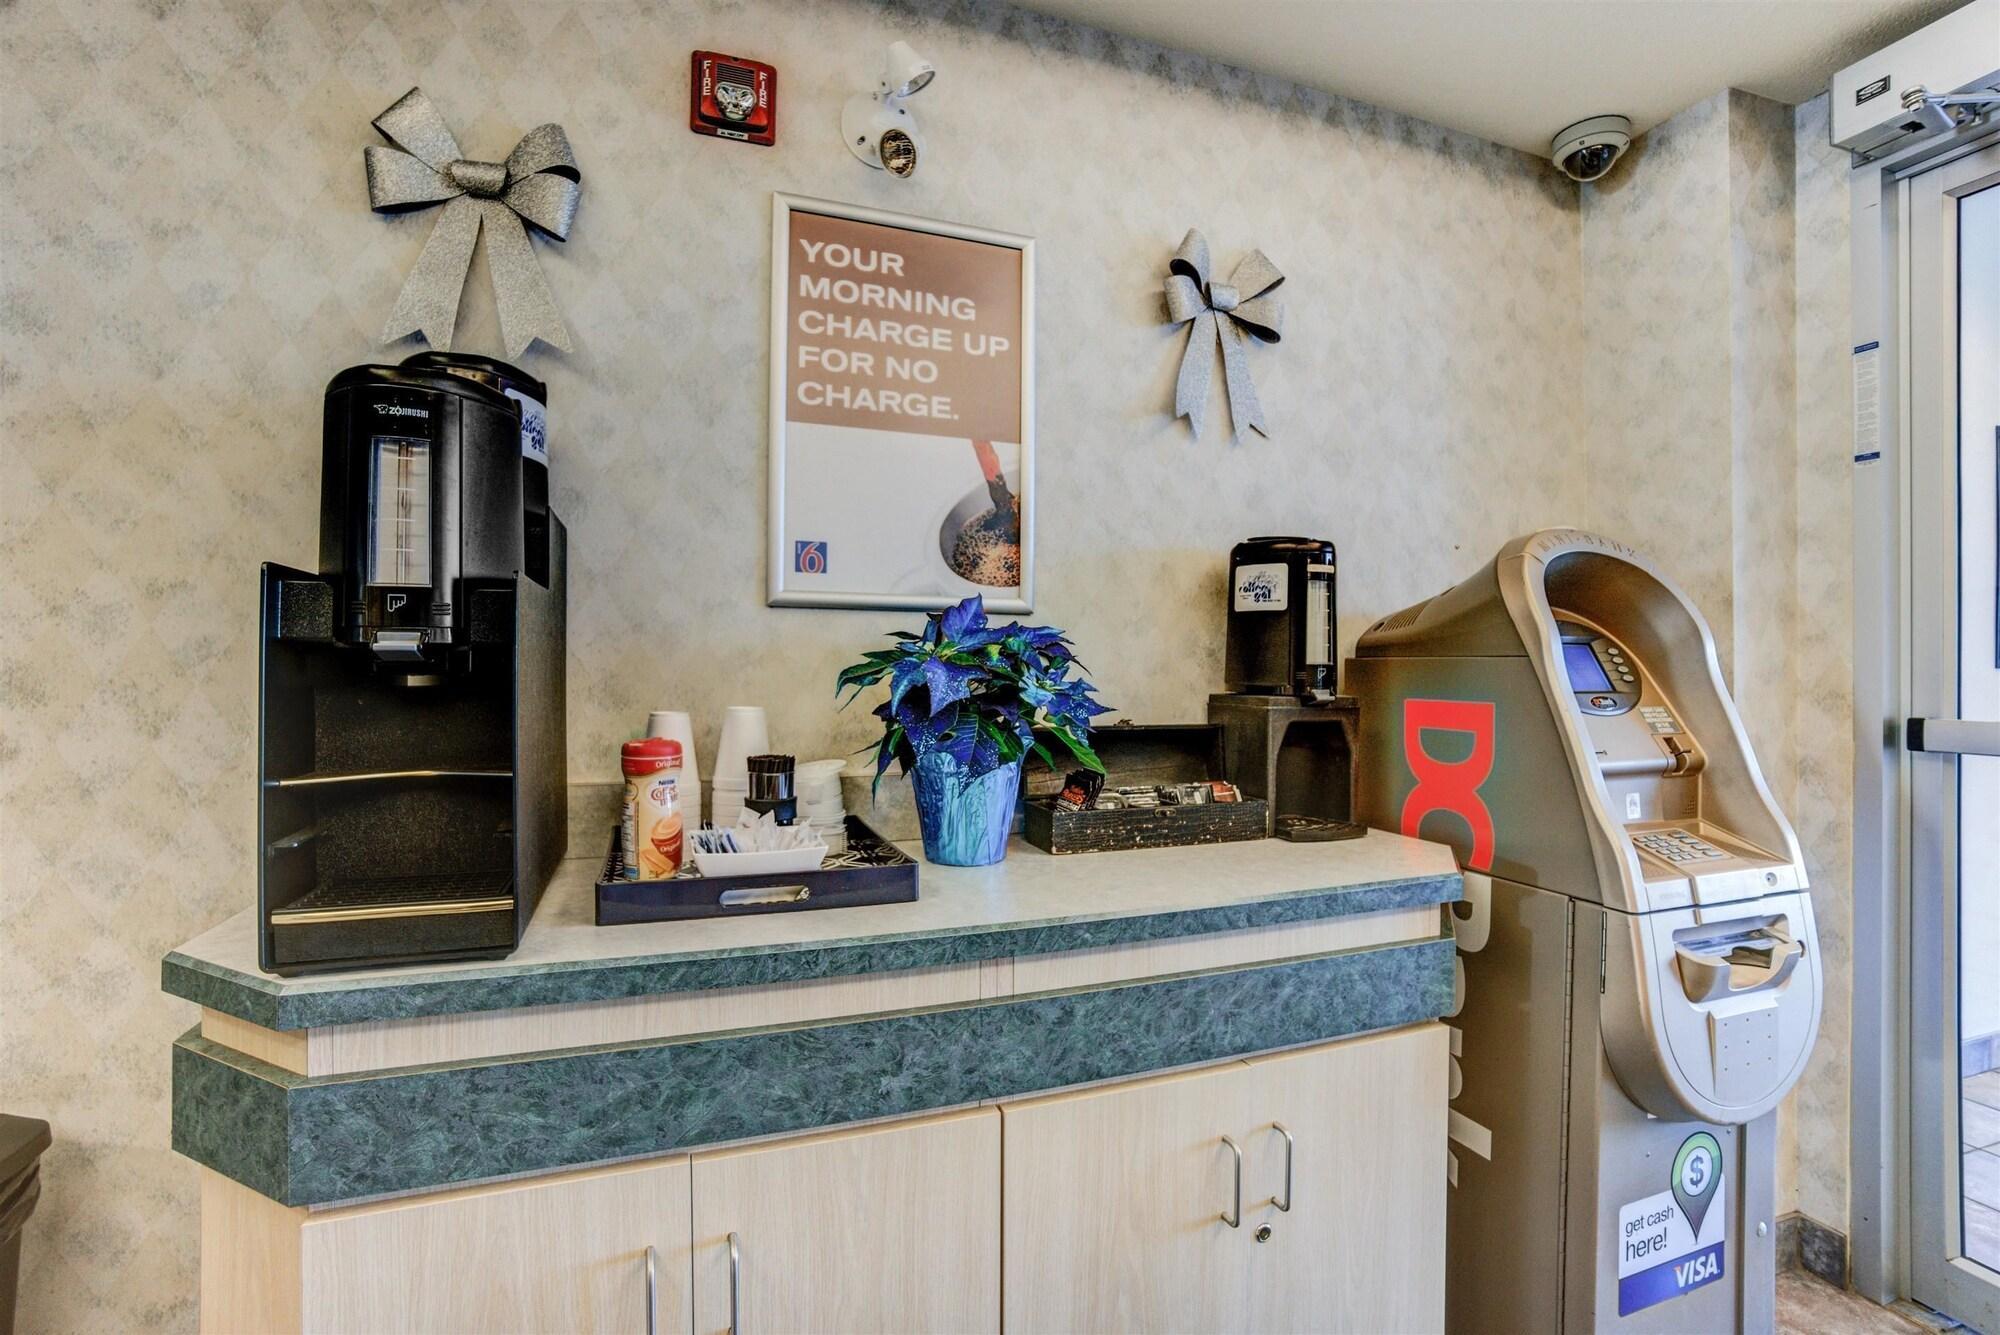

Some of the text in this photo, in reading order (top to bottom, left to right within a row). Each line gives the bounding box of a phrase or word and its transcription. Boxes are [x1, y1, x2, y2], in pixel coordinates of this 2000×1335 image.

[703, 60, 712, 96] FIRE
[759, 71, 768, 109] FIRE
[800, 238, 905, 277] YOUR
[799, 274, 977, 322] MORNING
[798, 310, 1010, 358] CHARGE UP
[798, 345, 939, 384] FOR NO
[388, 405, 429, 418] ZOJIRUSHI
[797, 380, 959, 420] CHARGE.
[800, 541, 825, 574] 6
[1625, 1205, 1674, 1237] get cash
[1625, 1227, 1668, 1262] here!
[1674, 1253, 1719, 1288] VISA
